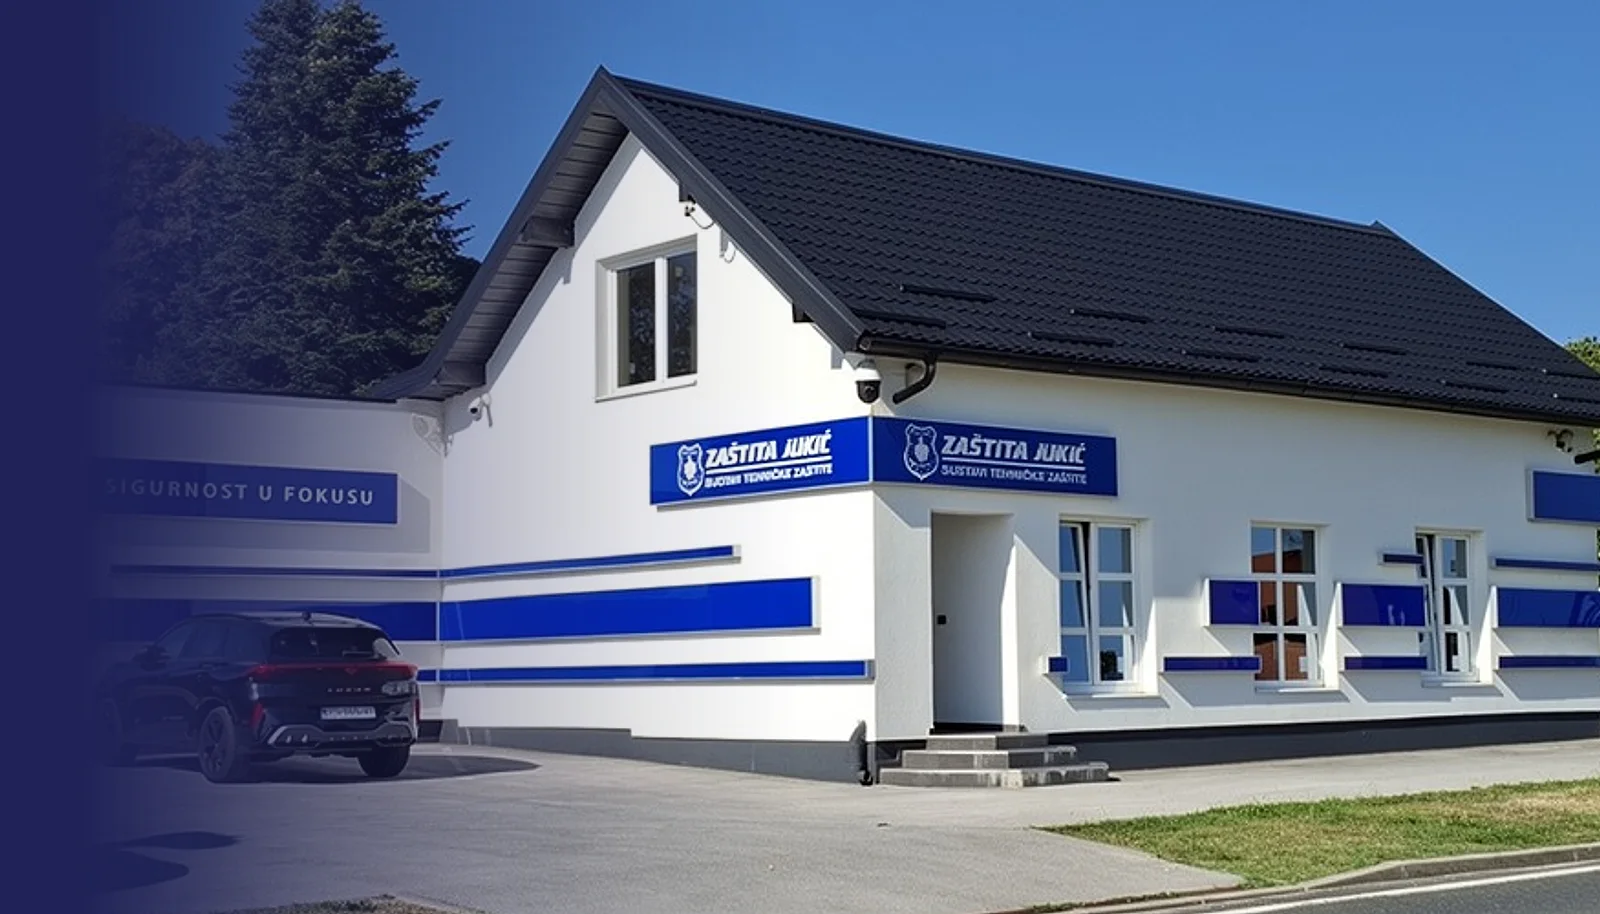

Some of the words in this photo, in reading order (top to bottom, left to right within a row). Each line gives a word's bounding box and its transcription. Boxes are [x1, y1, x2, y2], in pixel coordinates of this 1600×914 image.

[705, 441, 777, 468] ZAŠTITA
[781, 428, 832, 459] JUKIĆ
[941, 433, 1028, 460] ZAŠTITA
[1033, 442, 1086, 464] JUKIĆ
[105, 477, 249, 501] SIGURNOST
[258, 484, 273, 501] U
[284, 485, 374, 507] FOKUSU
